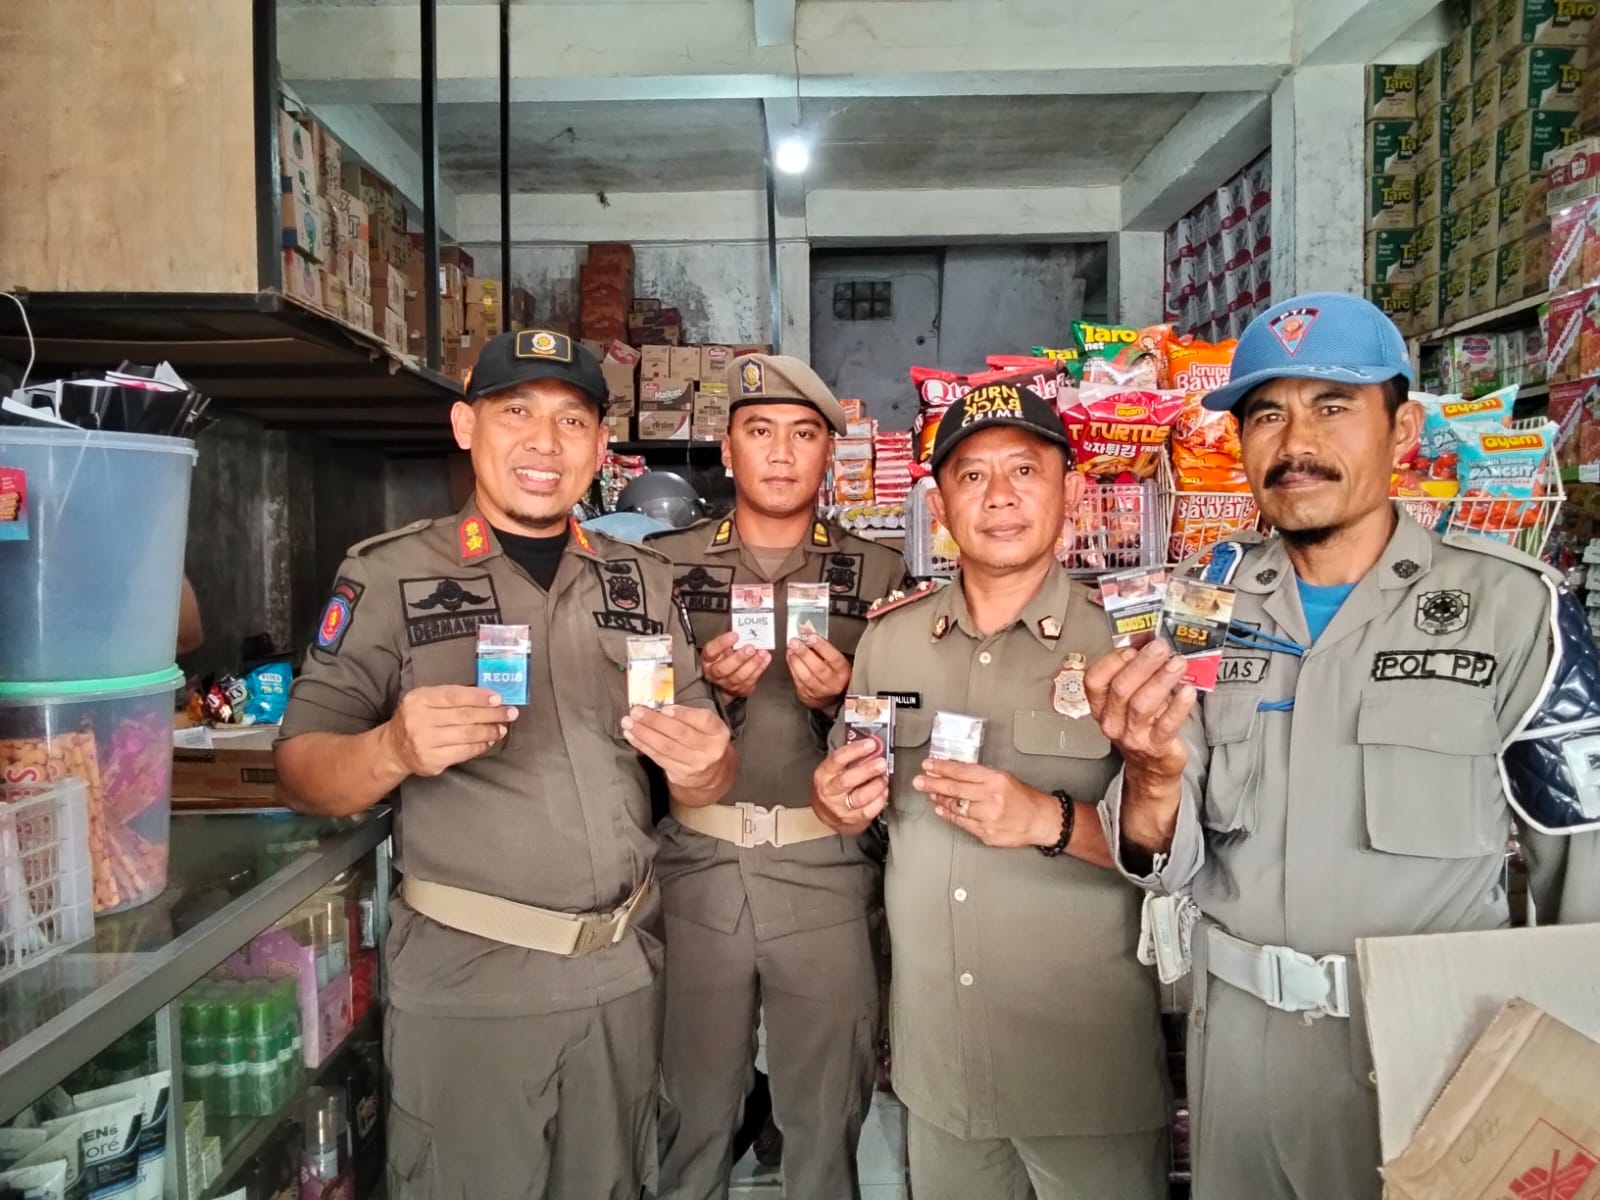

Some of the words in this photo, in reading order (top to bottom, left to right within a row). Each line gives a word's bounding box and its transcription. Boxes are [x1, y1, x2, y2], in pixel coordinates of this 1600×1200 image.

[1383, 76, 1413, 90] Taro
[1382, 188, 1411, 202] Taro
[1380, 297, 1410, 310] Taro
[1080, 325, 1137, 343] Taro
[1084, 342, 1105, 351] net
[1191, 364, 1231, 377] krupu
[963, 385, 1019, 404] TURN
[1444, 397, 1497, 413] ayam
[961, 410, 1025, 427] CRIME
[1090, 422, 1170, 443] TURTOS
[1485, 435, 1538, 449] ayam
[1468, 465, 1536, 480] PANGSIT
[409, 614, 500, 643] DERMAWAN
[737, 616, 769, 627] LOUIS
[1176, 624, 1208, 641] BSJ
[1379, 655, 1436, 676] POL
[1452, 656, 1487, 679] PP
